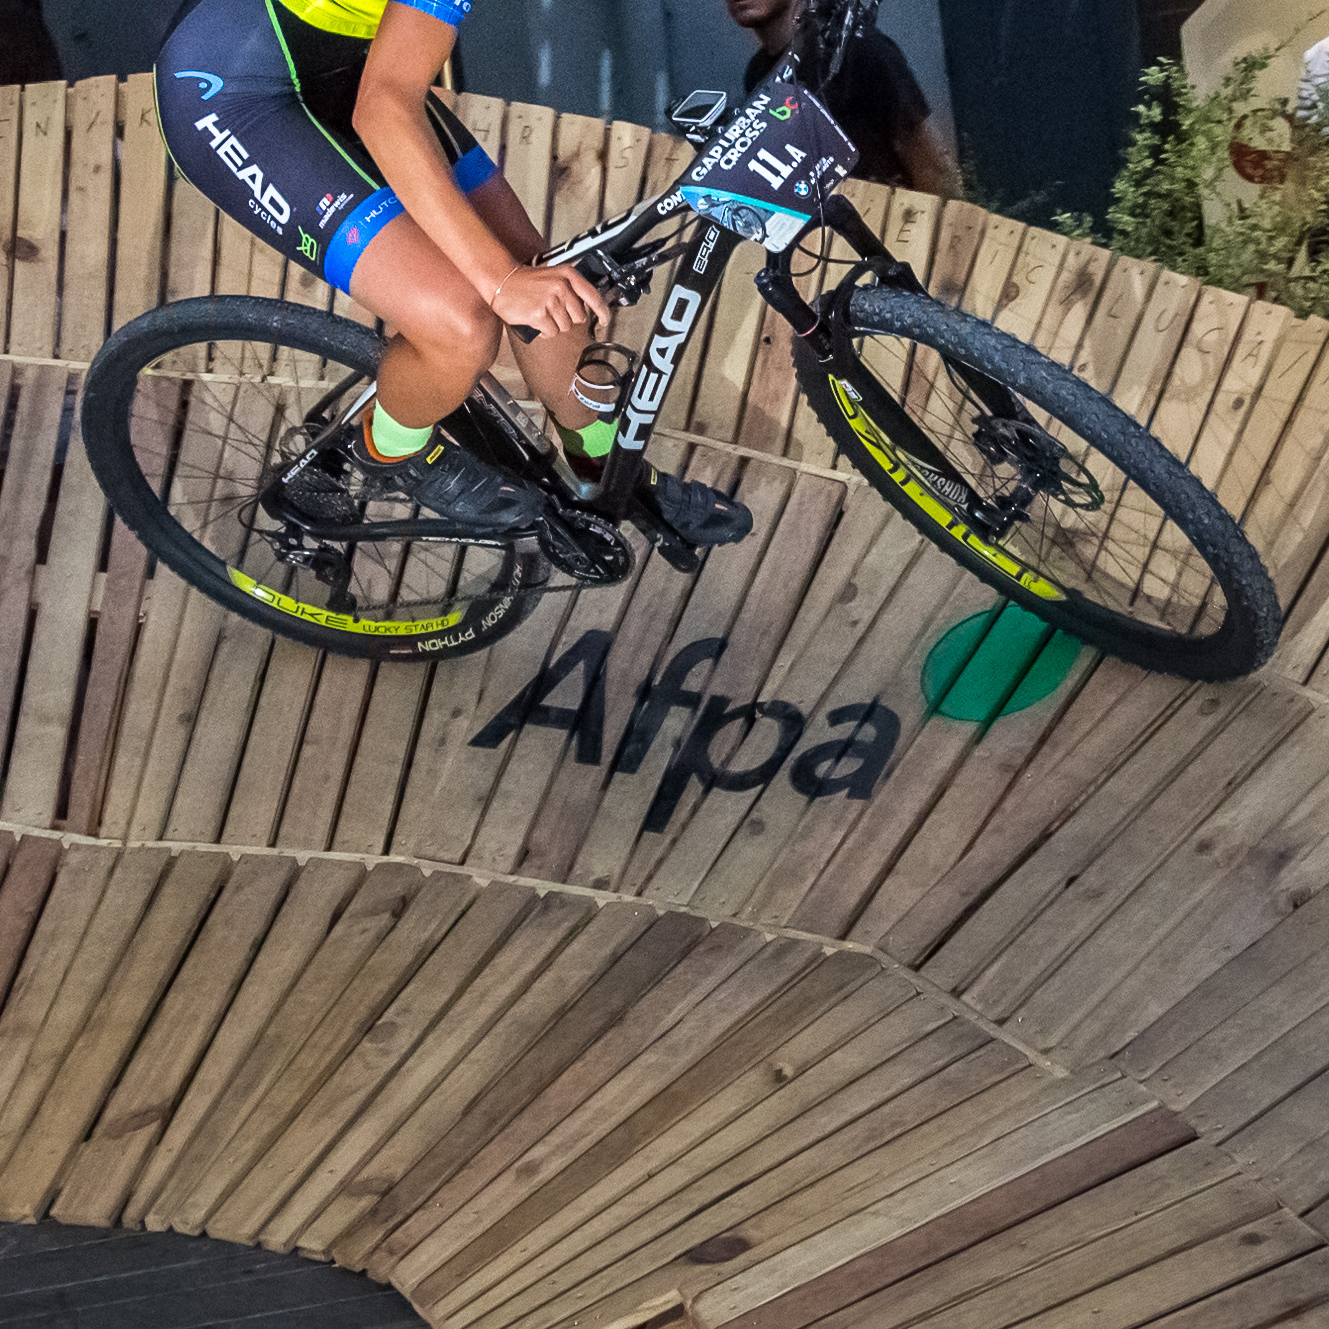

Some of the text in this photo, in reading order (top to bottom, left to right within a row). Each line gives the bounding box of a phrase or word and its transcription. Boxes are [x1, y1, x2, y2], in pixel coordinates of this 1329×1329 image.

[690, 93, 771, 182] GAP URBAN
[718, 120, 769, 171] CROSS
[194, 112, 292, 226] HEAD
[248, 198, 284, 237] cycles
[616, 283, 702, 452] HEAD
[281, 448, 318, 484] HEAD
[255, 583, 349, 630] DUKE
[362, 622, 401, 634] LUCKY
[417, 626, 476, 654] PYTHON
[469, 628, 903, 833] Afpa
